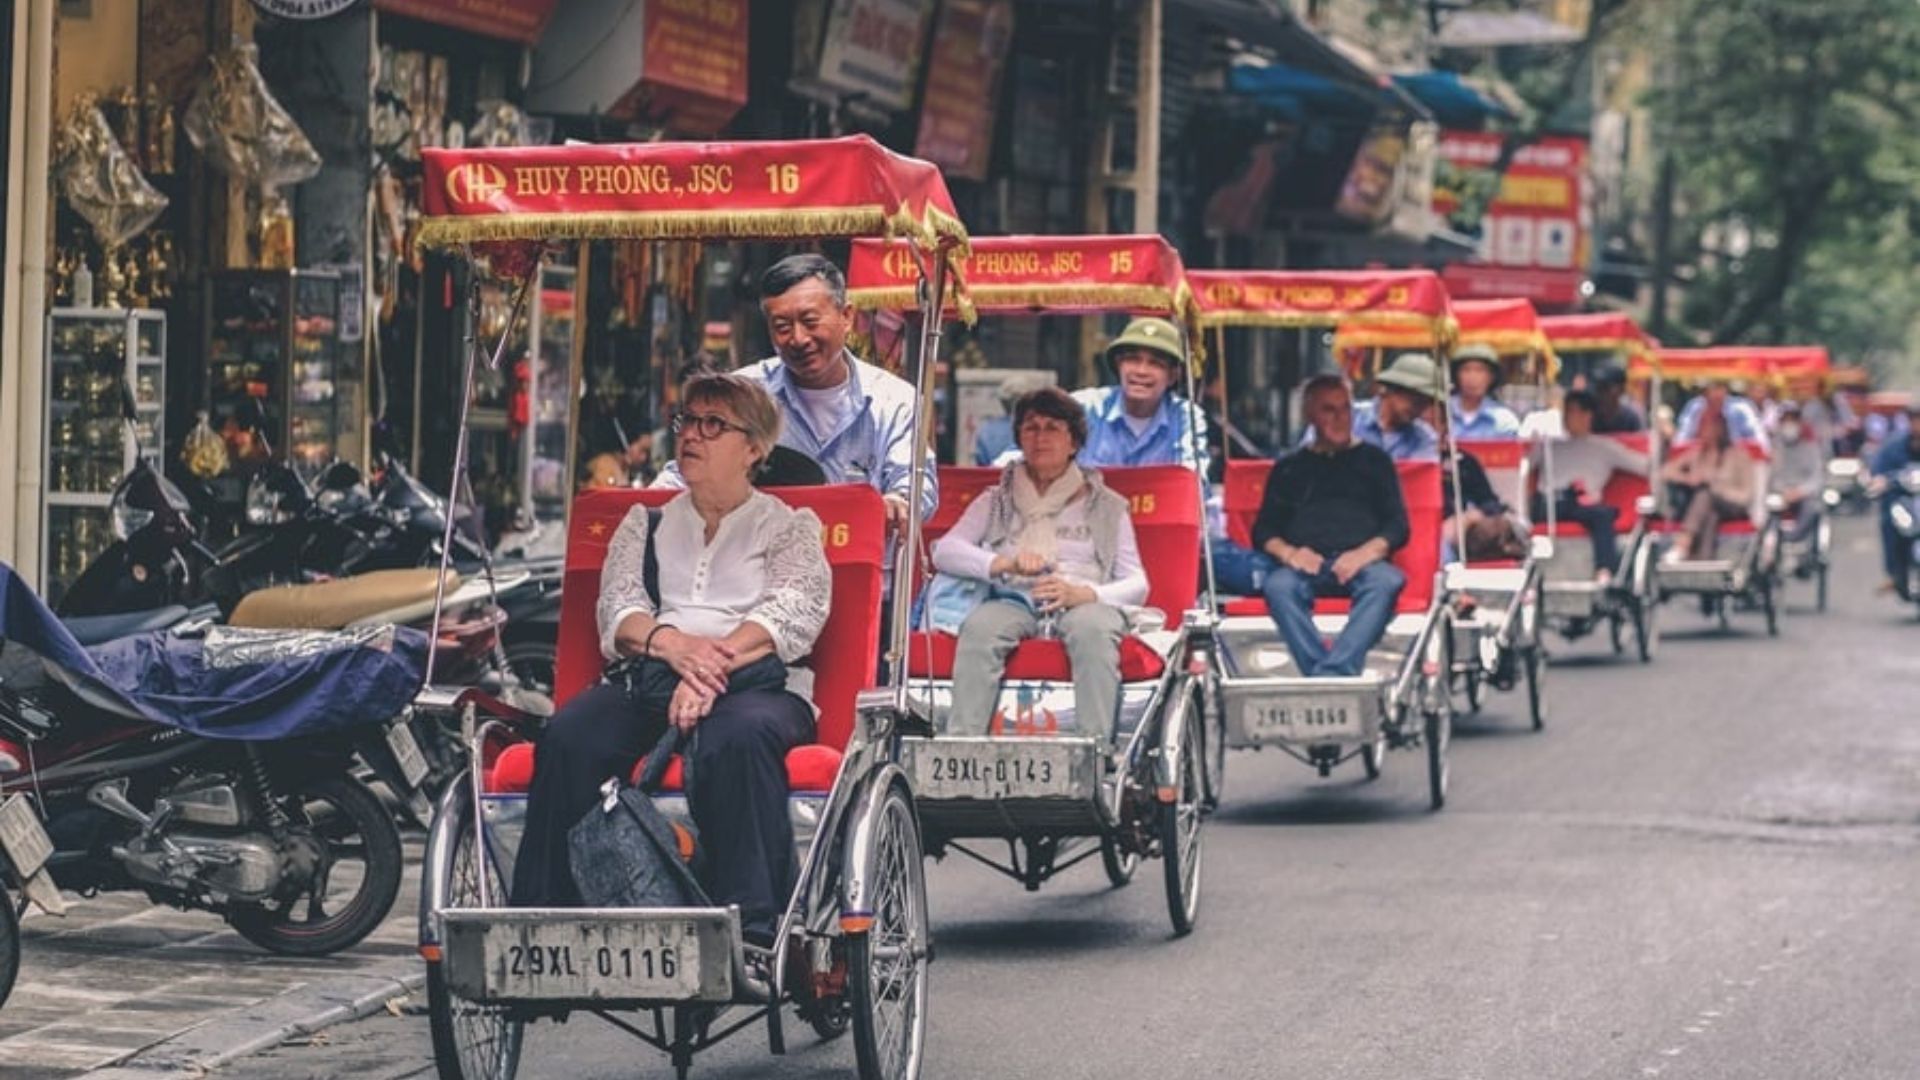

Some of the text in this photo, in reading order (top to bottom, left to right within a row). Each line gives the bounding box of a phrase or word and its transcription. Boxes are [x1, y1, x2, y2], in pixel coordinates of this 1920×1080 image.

[514, 165, 571, 196] HUY
[766, 163, 800, 194] 16
[1108, 251, 1133, 274] 15
